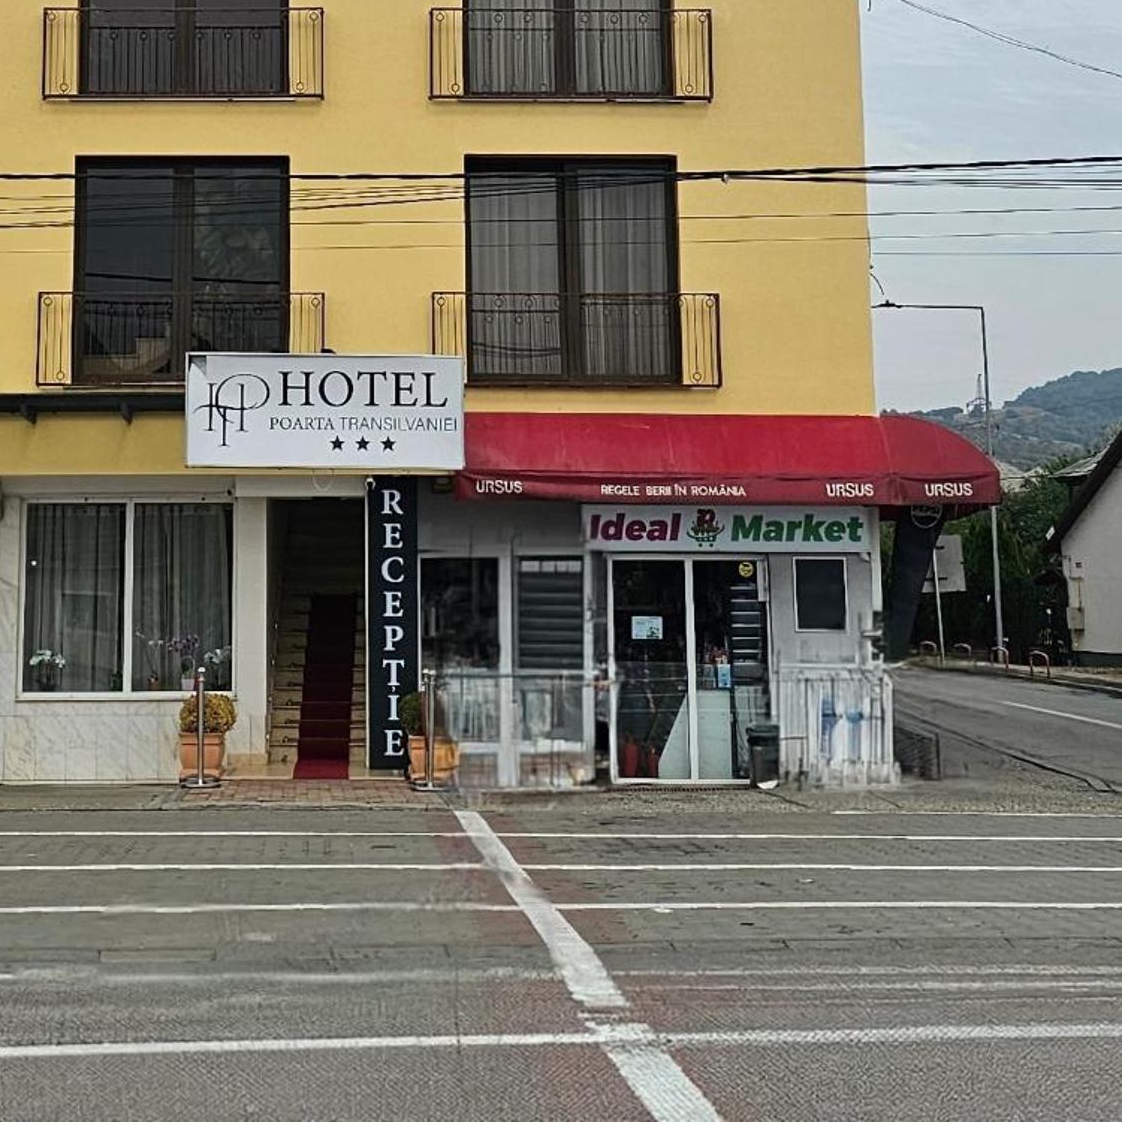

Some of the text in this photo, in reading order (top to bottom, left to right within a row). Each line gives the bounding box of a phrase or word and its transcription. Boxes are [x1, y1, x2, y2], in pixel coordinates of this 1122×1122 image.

[278, 370, 448, 408] HOTEL
[269, 416, 458, 433] POARTA TRANSILVANIEI
[476, 480, 523, 494] URSUS
[600, 484, 640, 496] REGELE
[826, 482, 875, 497] URSUS
[925, 482, 973, 497] URSUS
[589, 512, 864, 543] Ideal Market
